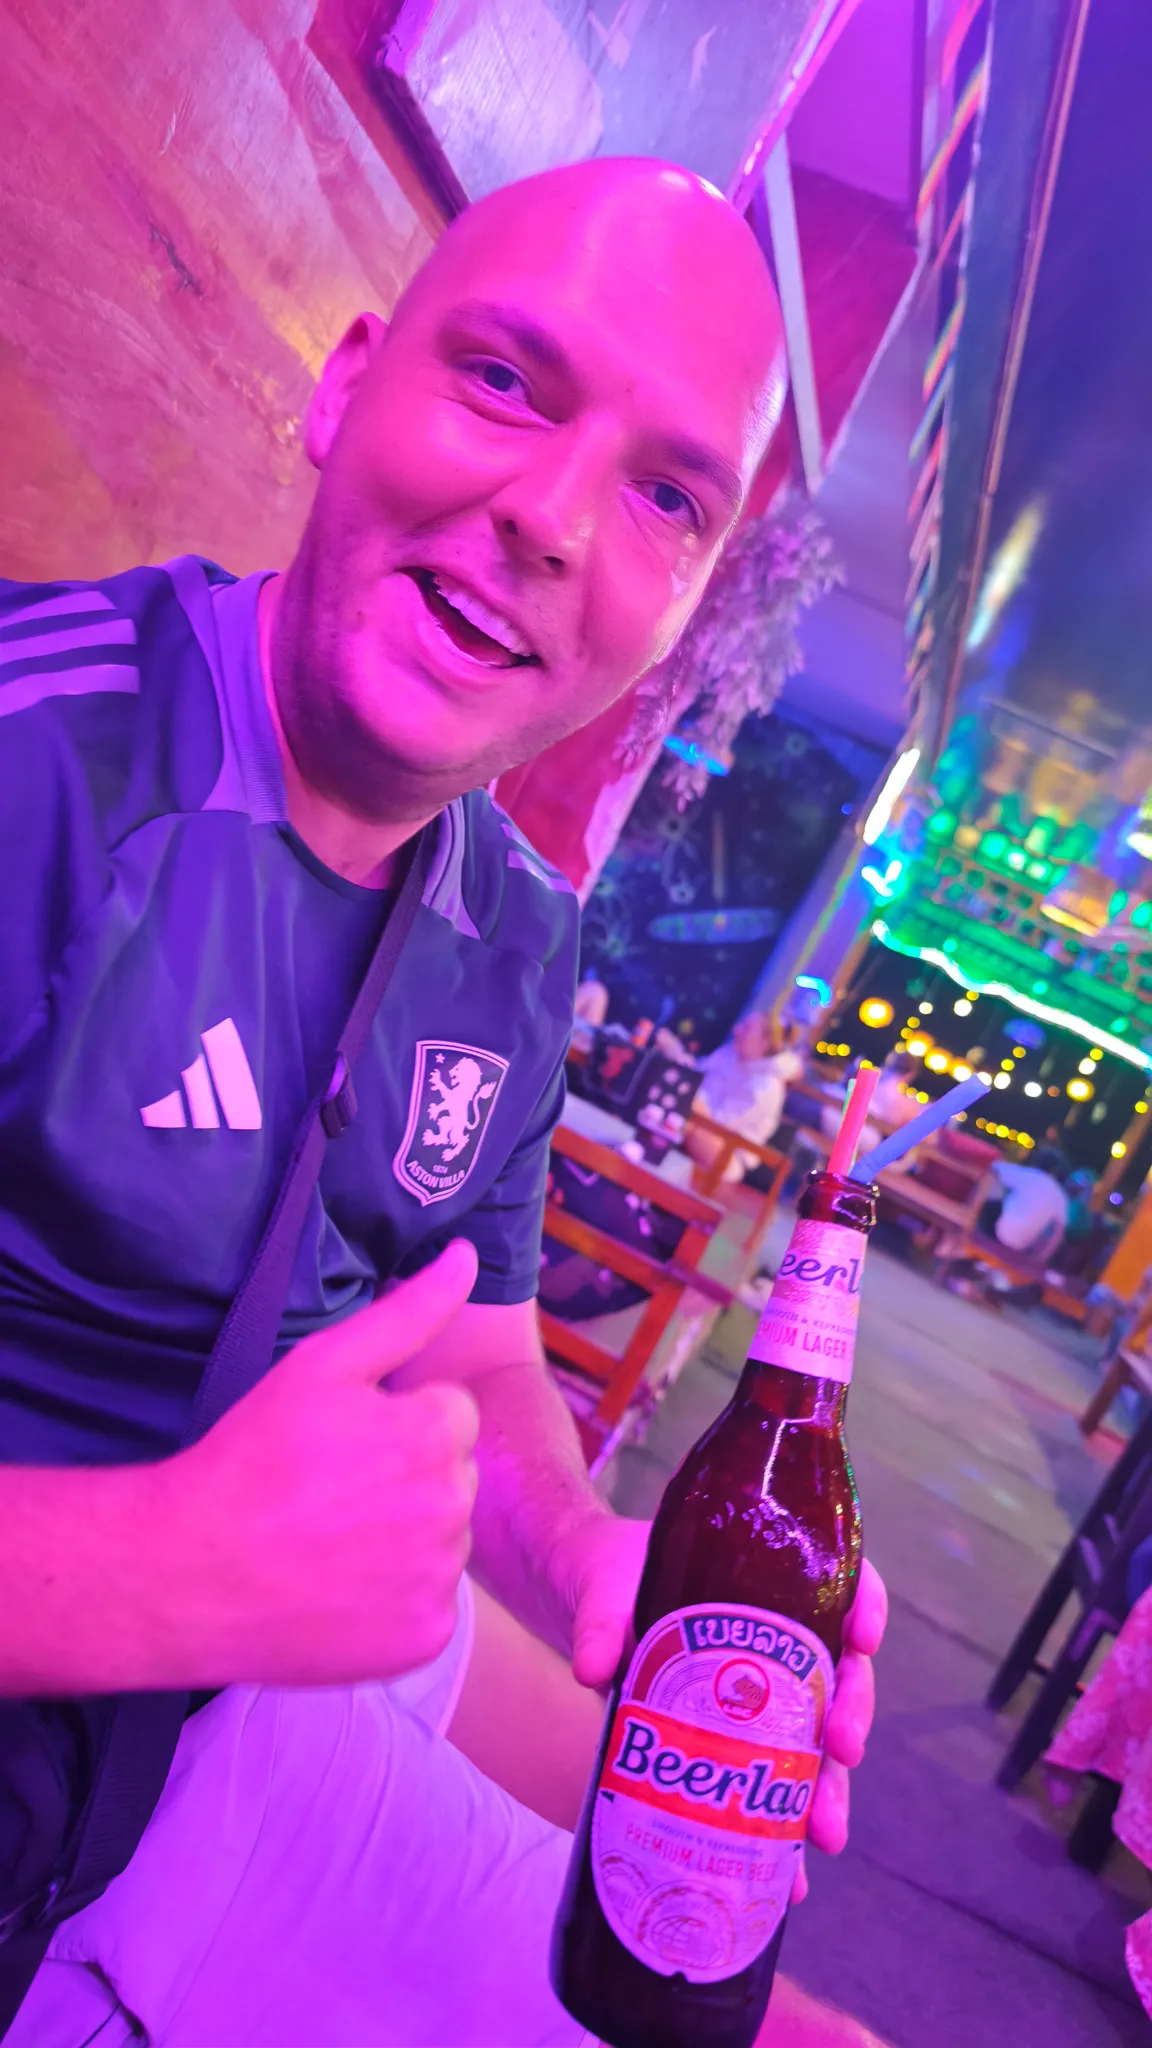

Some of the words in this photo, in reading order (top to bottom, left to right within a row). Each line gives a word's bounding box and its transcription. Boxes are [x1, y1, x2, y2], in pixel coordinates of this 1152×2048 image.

[407, 1160, 439, 1188] ASTON
[439, 1170, 465, 1188] VILLA
[693, 1618, 811, 1672] ເບຍລາວ
[615, 1720, 810, 1817] Beerlao
[624, 1822, 693, 1870] PREMIUM
[697, 1852, 744, 1880] LAGER
